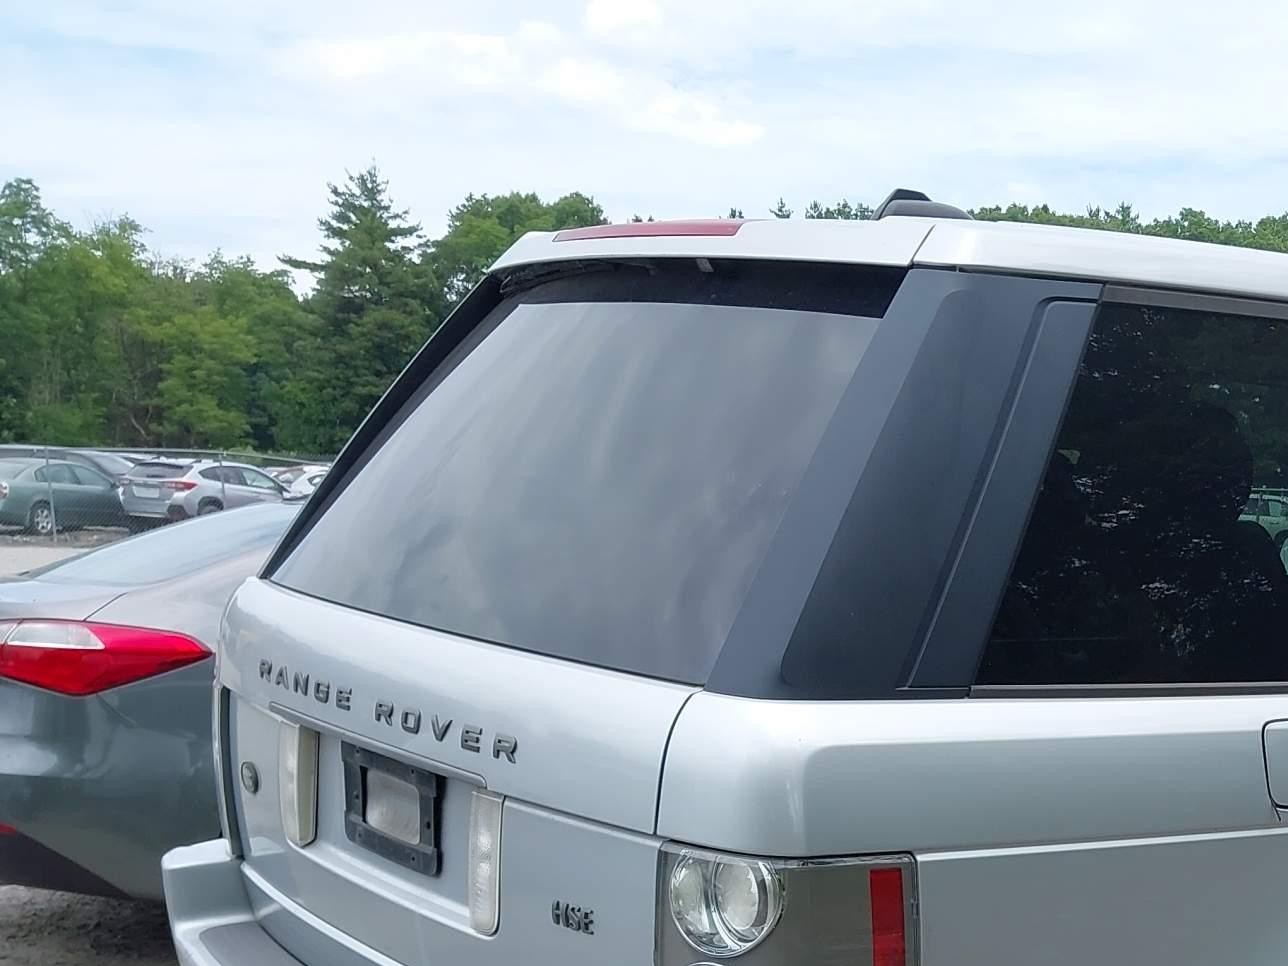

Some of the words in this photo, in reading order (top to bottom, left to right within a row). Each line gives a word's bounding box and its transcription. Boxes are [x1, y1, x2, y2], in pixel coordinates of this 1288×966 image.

[258, 658, 352, 711] RANGE
[374, 701, 519, 764] ROVER
[551, 900, 595, 935] HSE
